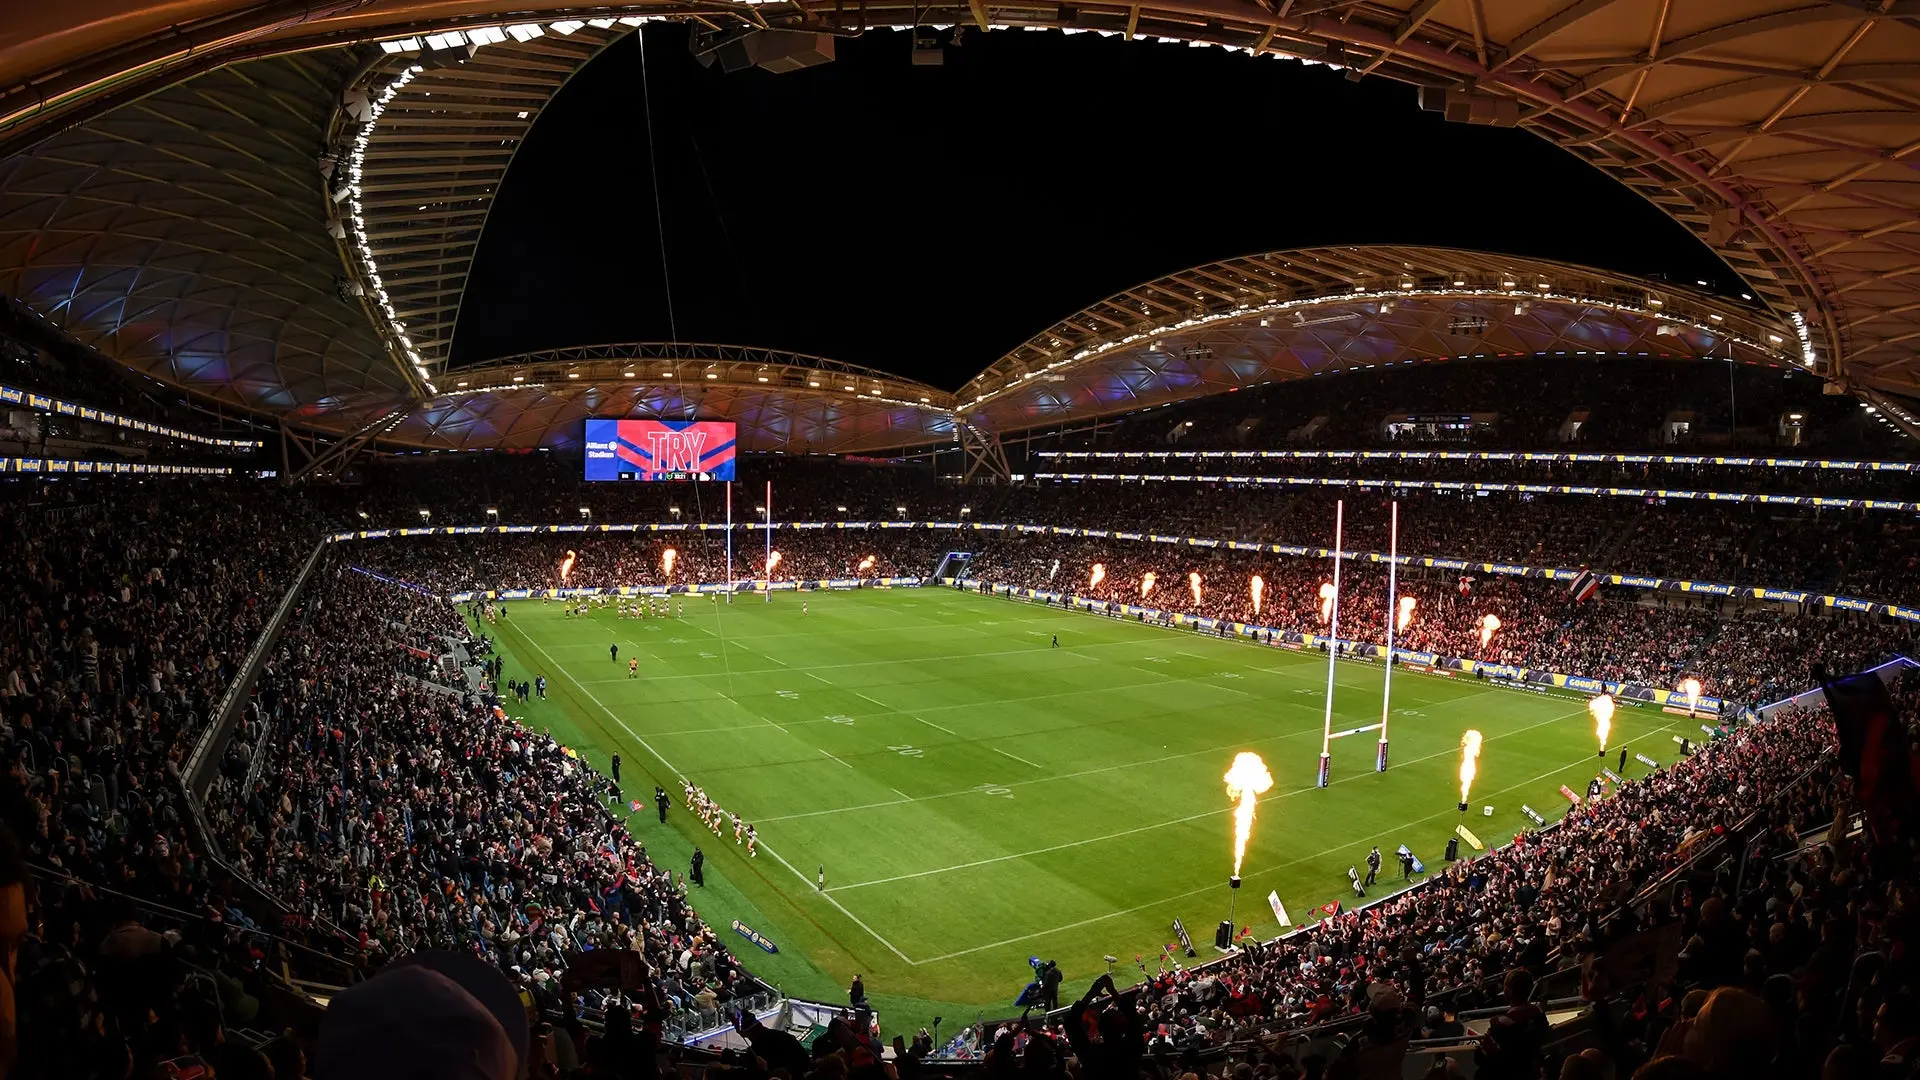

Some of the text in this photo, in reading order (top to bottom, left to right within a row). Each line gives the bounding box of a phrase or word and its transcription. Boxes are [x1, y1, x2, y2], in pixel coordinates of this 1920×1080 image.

[586, 442, 608, 450] Allianz
[648, 431, 706, 471] TRY
[588, 451, 614, 459] Stadium
[1493, 566, 1522, 574] GOODYEAR
[1622, 578, 1655, 587] GOODYEAR
[1693, 584, 1727, 594] GOODYEAR
[1765, 591, 1800, 601] GOODYEAR
[1837, 600, 1867, 610] GOODYEAR
[1670, 695, 1719, 708] GOOYEAR
